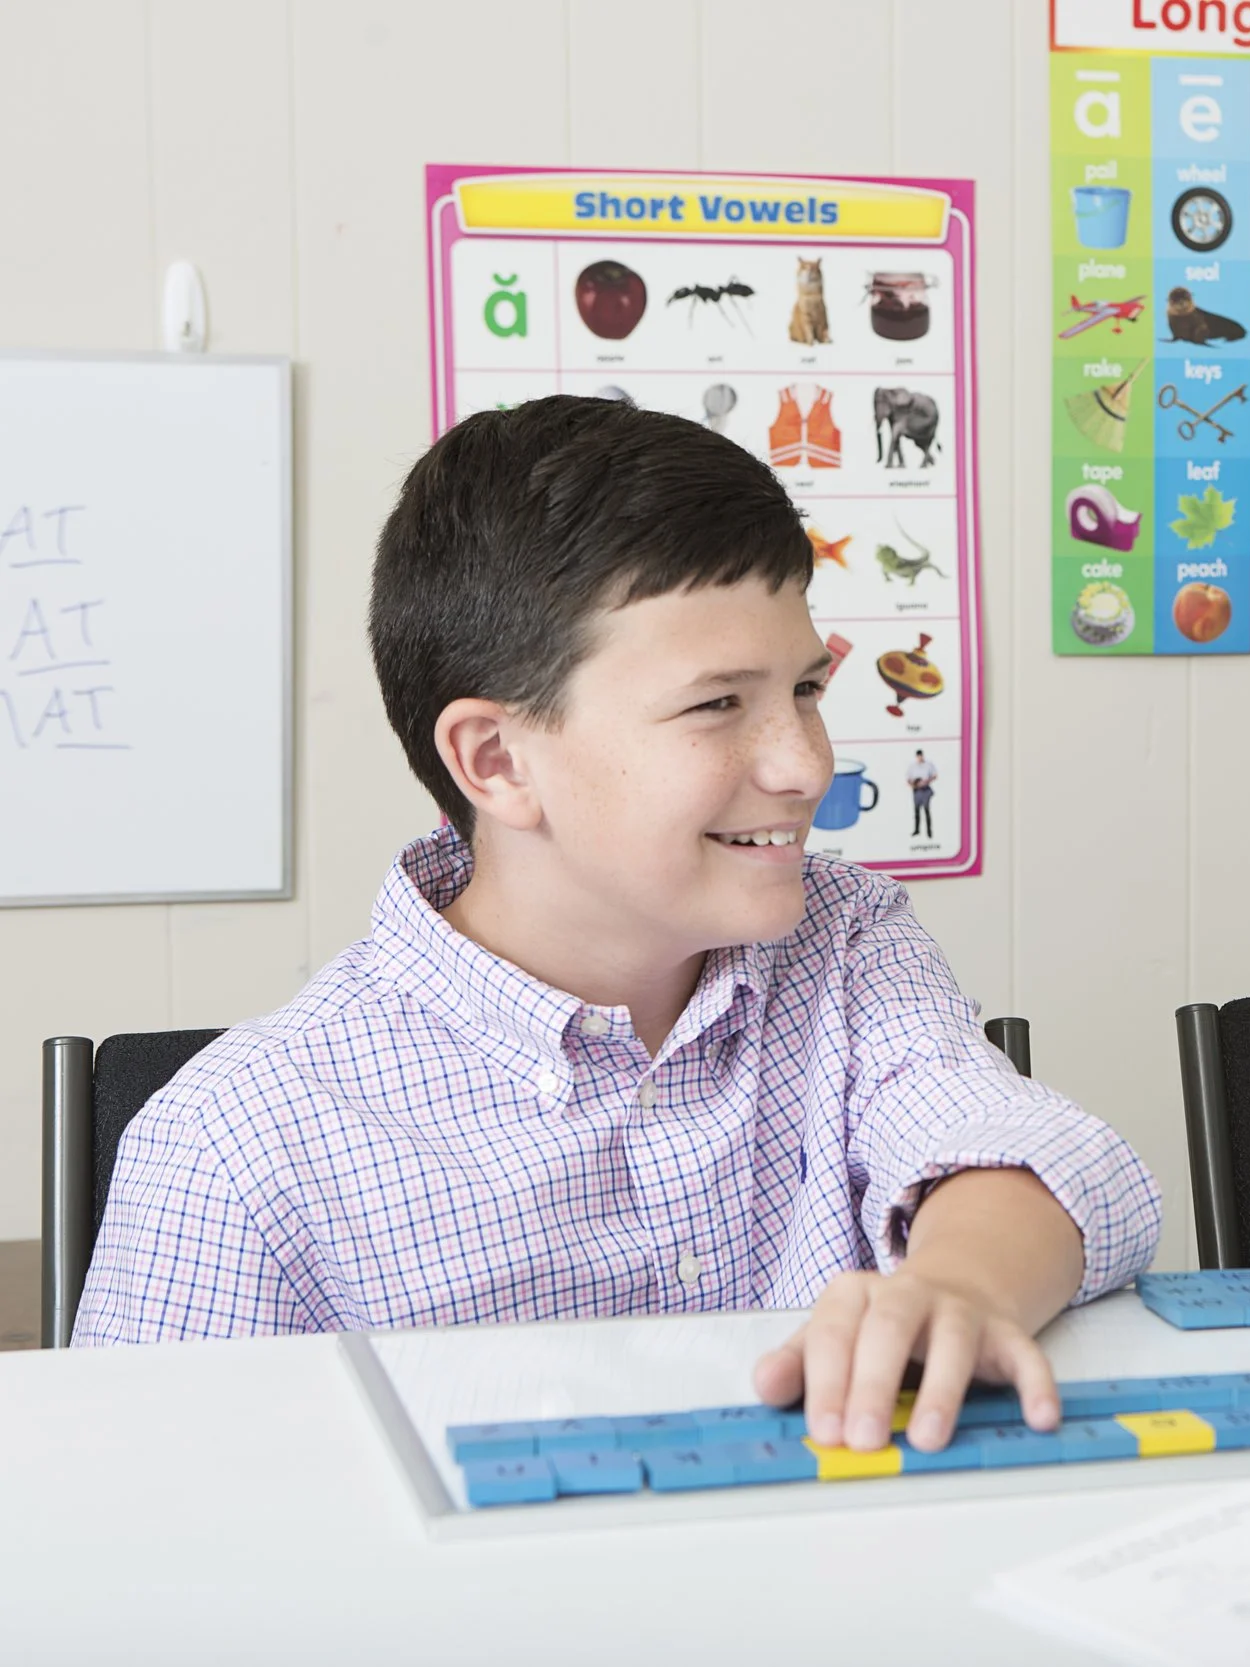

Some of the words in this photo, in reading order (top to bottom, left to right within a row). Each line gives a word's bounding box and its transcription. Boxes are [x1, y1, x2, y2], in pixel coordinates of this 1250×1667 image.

[1084, 161, 1117, 181] pail
[1177, 164, 1227, 184] wheel
[574, 191, 685, 221] Short
[698, 195, 839, 225] Vowels
[1078, 261, 1126, 281] plane
[1185, 263, 1220, 282] seal
[1083, 361, 1123, 379] rake
[1185, 361, 1222, 382] keys
[1082, 463, 1123, 485] tape
[1187, 462, 1220, 482] leaf
[1082, 560, 1123, 579] cake
[1177, 560, 1228, 581] peach
[9, 597, 105, 661] AT
